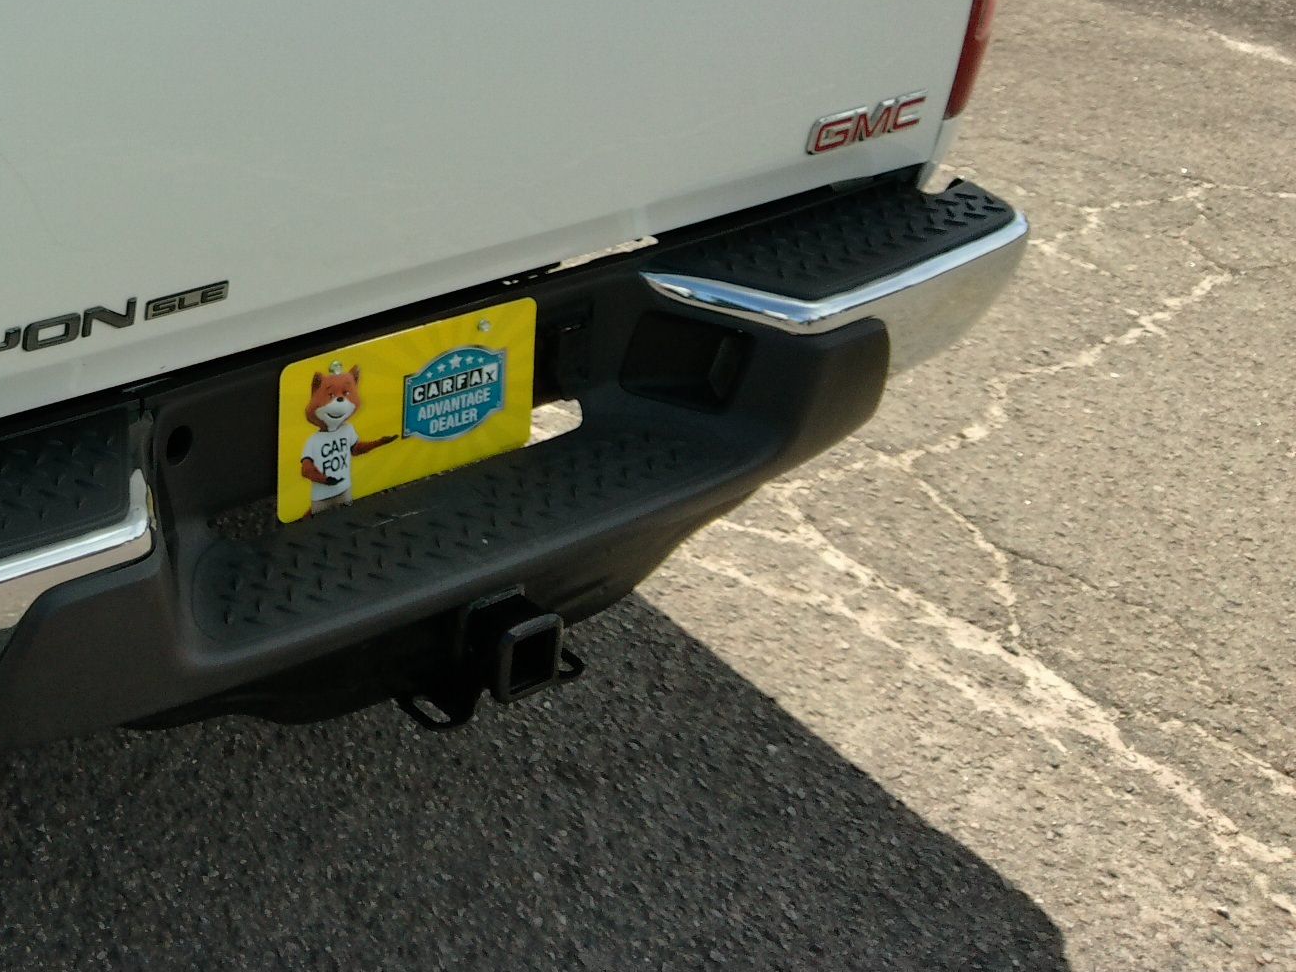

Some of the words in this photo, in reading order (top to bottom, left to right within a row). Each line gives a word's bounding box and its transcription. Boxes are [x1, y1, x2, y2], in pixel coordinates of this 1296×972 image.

[806, 88, 929, 155] GMC
[149, 282, 227, 319] SLE
[412, 367, 498, 404] CARFAX
[417, 387, 491, 422] ADVANTAGE
[429, 408, 478, 434] DEALER
[321, 437, 348, 458] CAR
[322, 454, 348, 475] FOX
